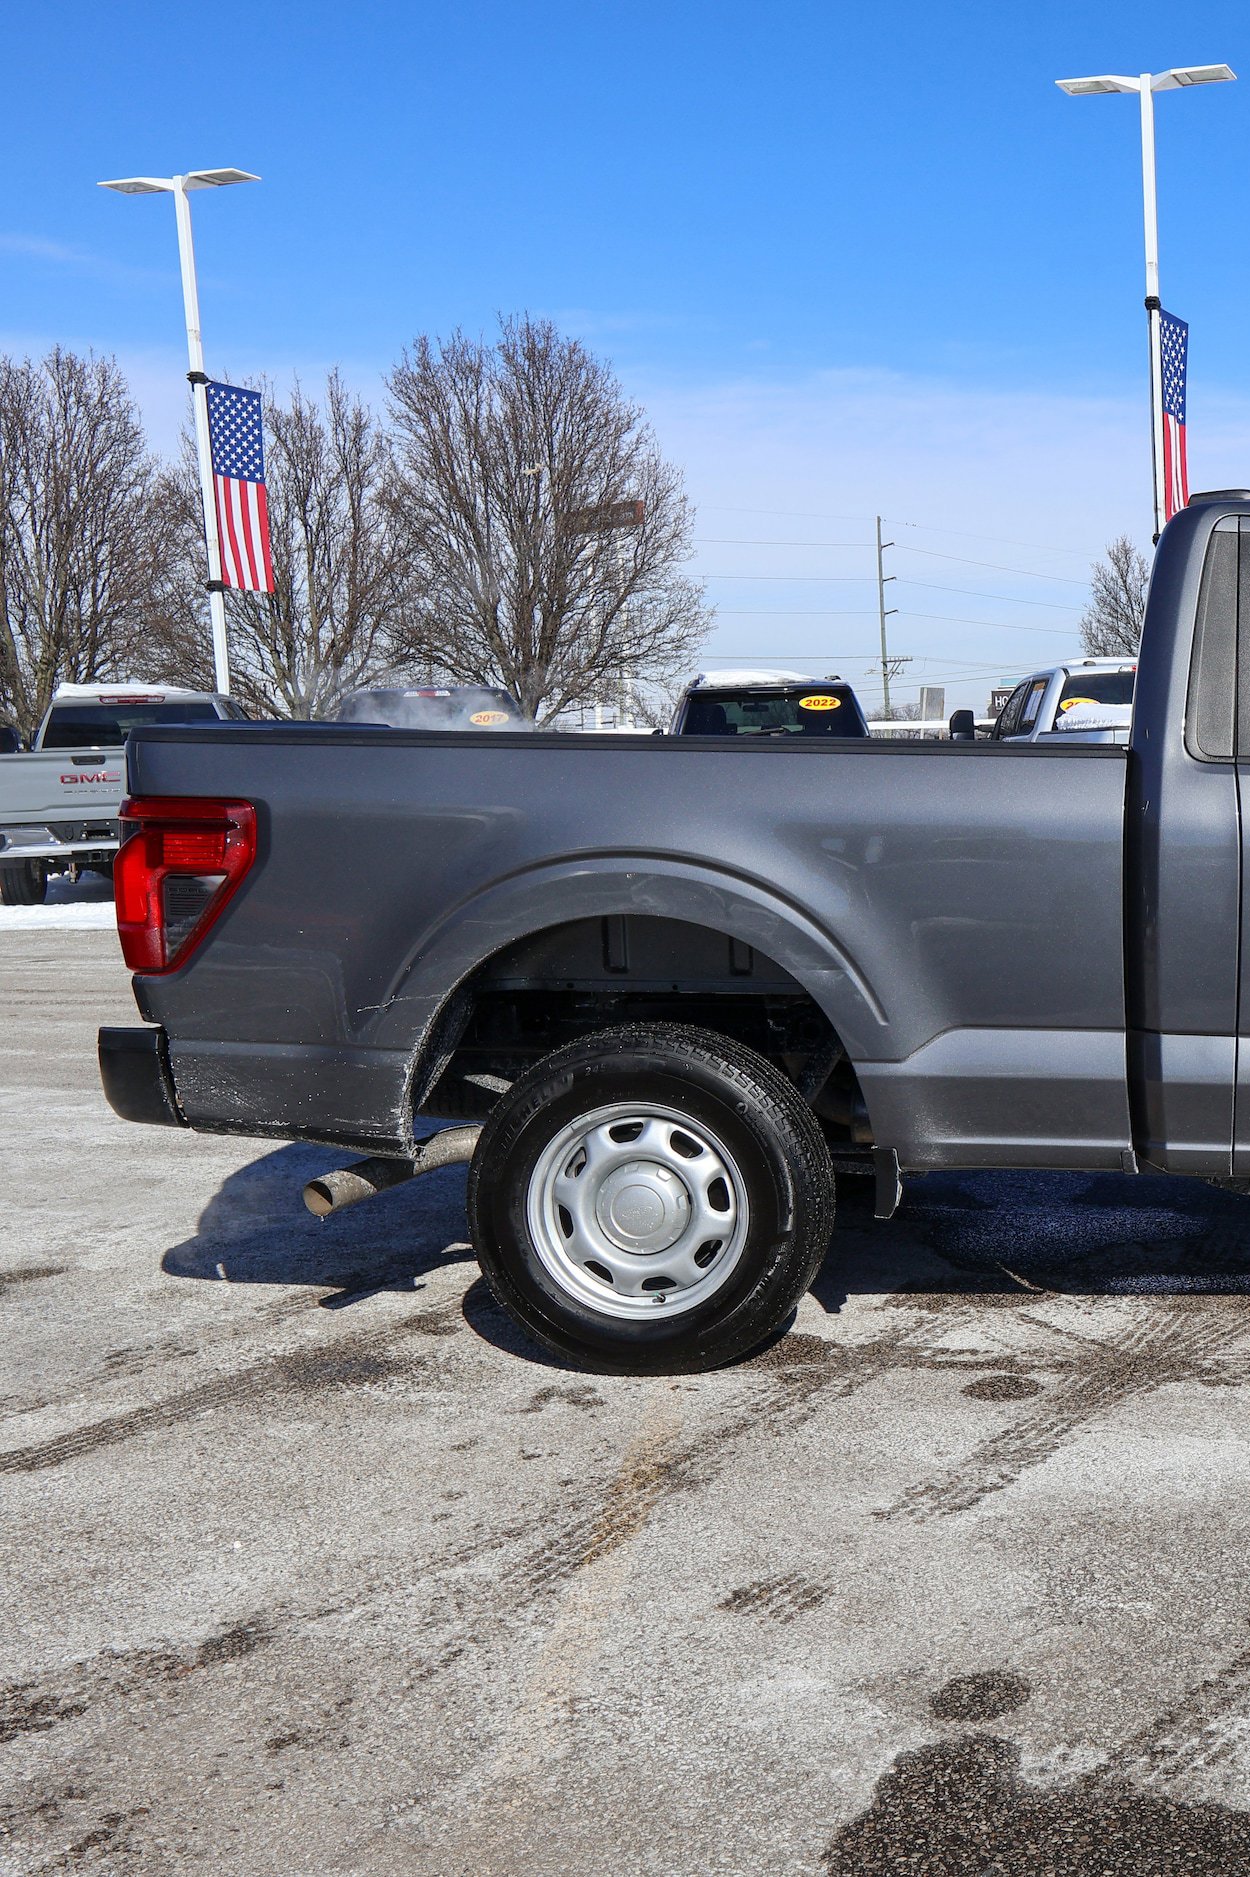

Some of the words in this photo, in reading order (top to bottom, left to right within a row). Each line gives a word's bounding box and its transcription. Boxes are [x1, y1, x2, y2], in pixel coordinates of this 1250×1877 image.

[805, 699, 836, 707] 2022
[474, 714, 505, 723] 2017
[60, 771, 121, 784] GMC
